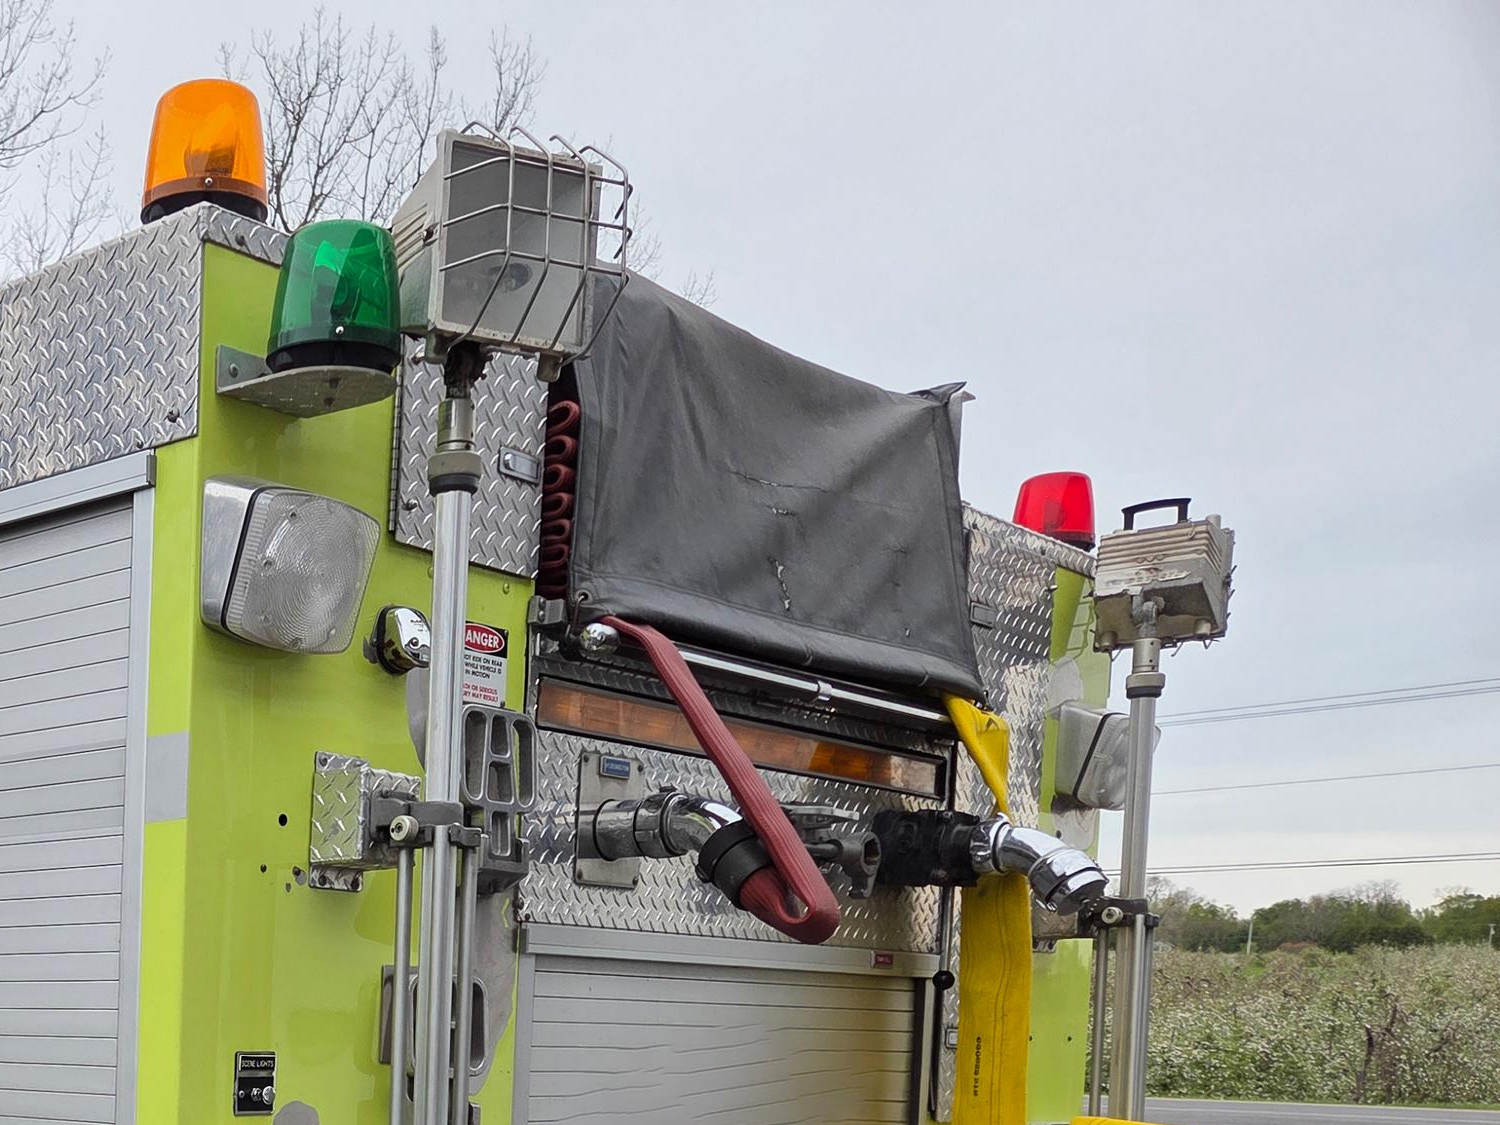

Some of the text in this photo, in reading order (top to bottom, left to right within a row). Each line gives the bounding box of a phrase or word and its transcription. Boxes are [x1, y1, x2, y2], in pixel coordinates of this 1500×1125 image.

[465, 630, 499, 649] ANGER
[480, 665, 496, 673] VEHICLE
[472, 670, 490, 679] MOTION
